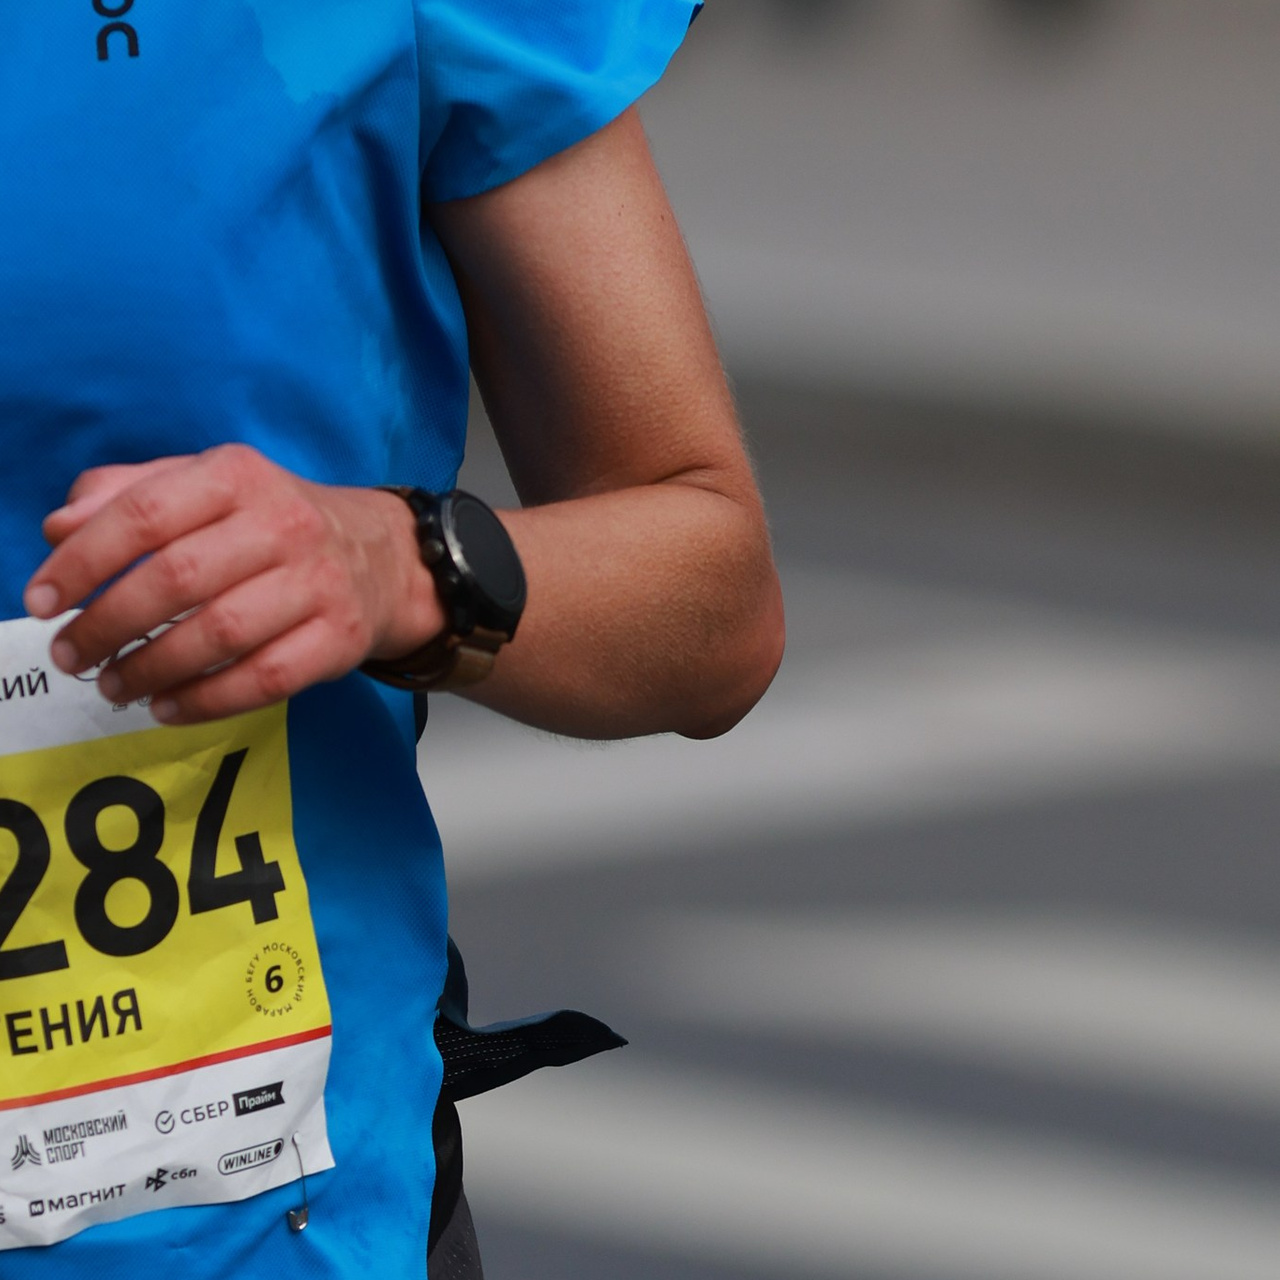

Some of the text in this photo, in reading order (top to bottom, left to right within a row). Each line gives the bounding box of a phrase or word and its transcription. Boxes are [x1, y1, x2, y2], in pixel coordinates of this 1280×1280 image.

[264, 965, 284, 993] 6
[181, 1090, 276, 1125] СБЕР Прайм
[43, 1109, 128, 1146] МОСКОВСКИЙ
[46, 1141, 86, 1164] СПОРТ
[223, 1146, 273, 1171] WINLINE
